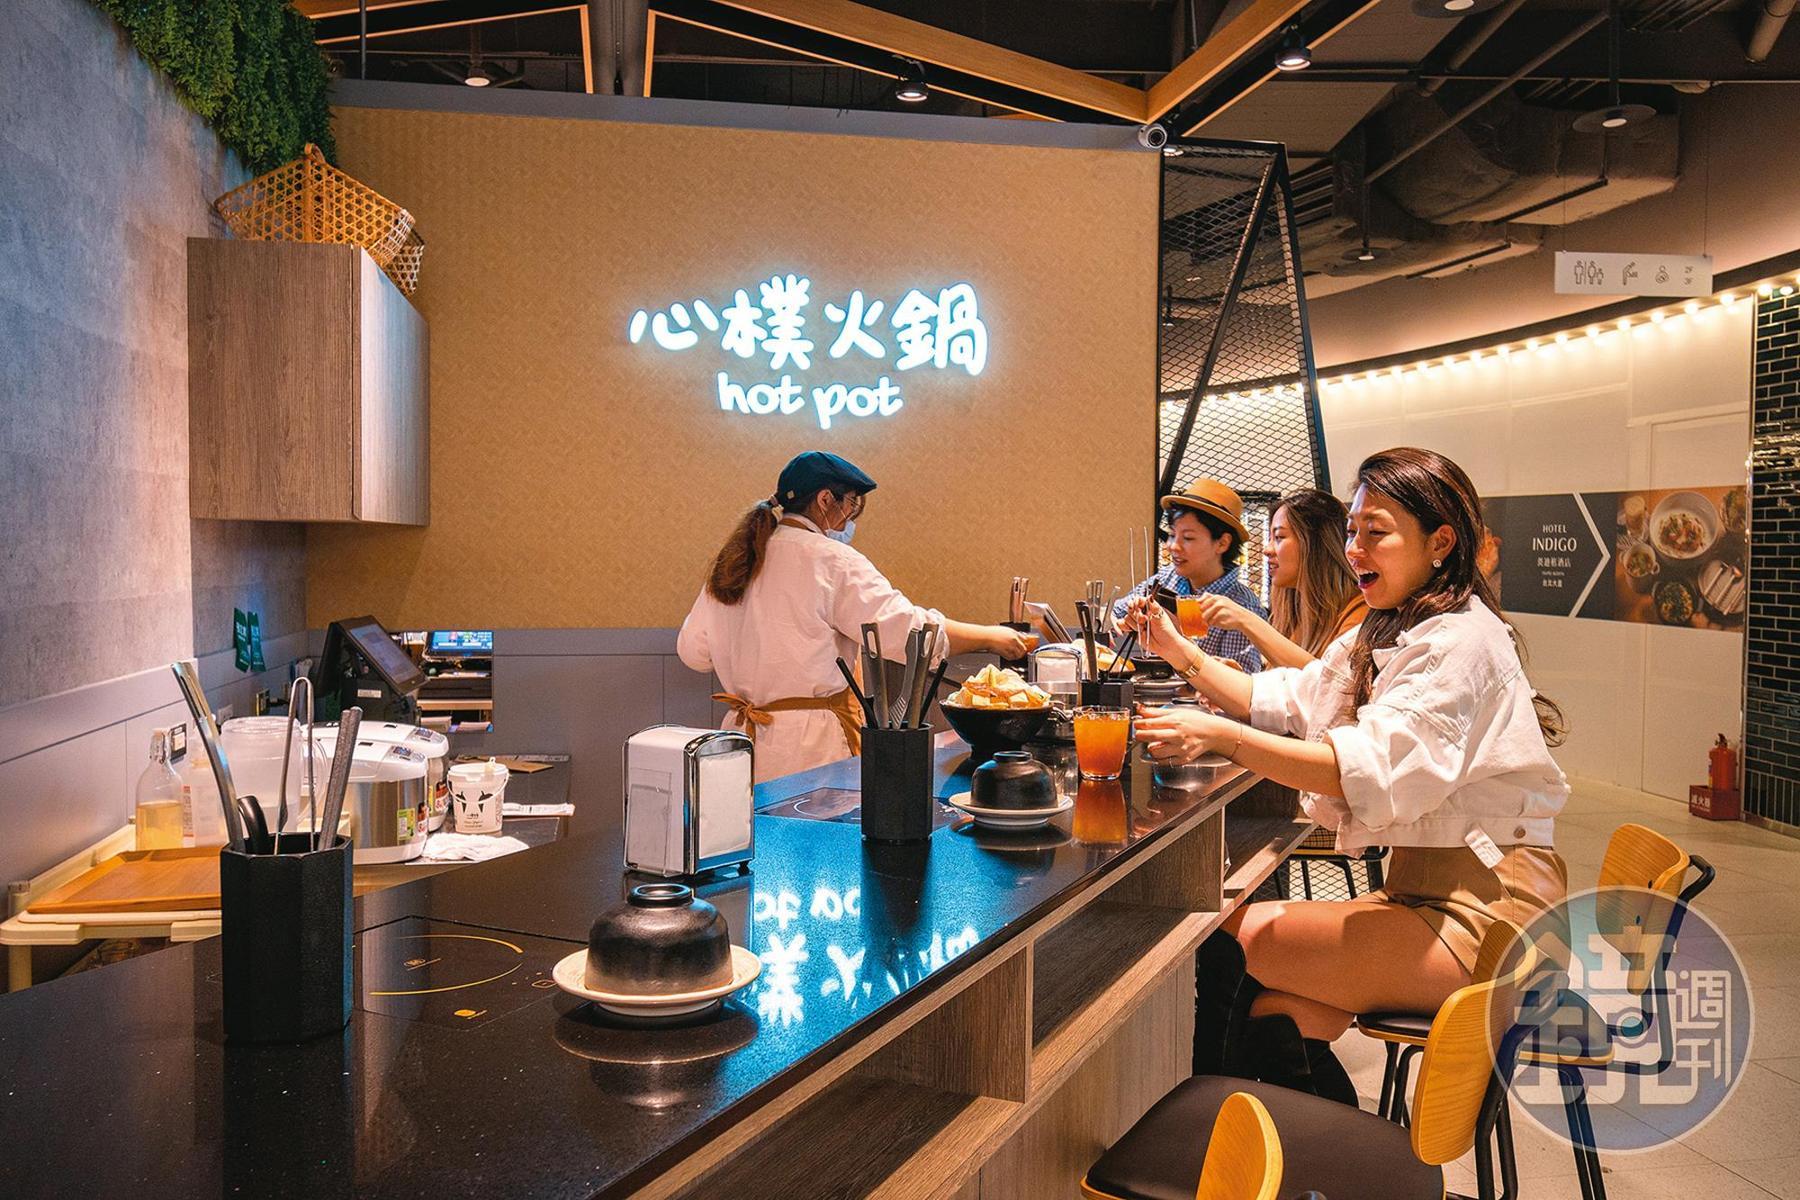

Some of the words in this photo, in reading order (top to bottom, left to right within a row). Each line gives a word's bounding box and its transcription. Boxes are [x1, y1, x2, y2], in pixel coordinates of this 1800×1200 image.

[629, 273, 988, 376] 心樸火鍋
[717, 371, 806, 415] hot
[811, 375, 904, 431] pot
[1532, 537, 1577, 552] INDIGO
[1542, 524, 1568, 534] HOTEL
